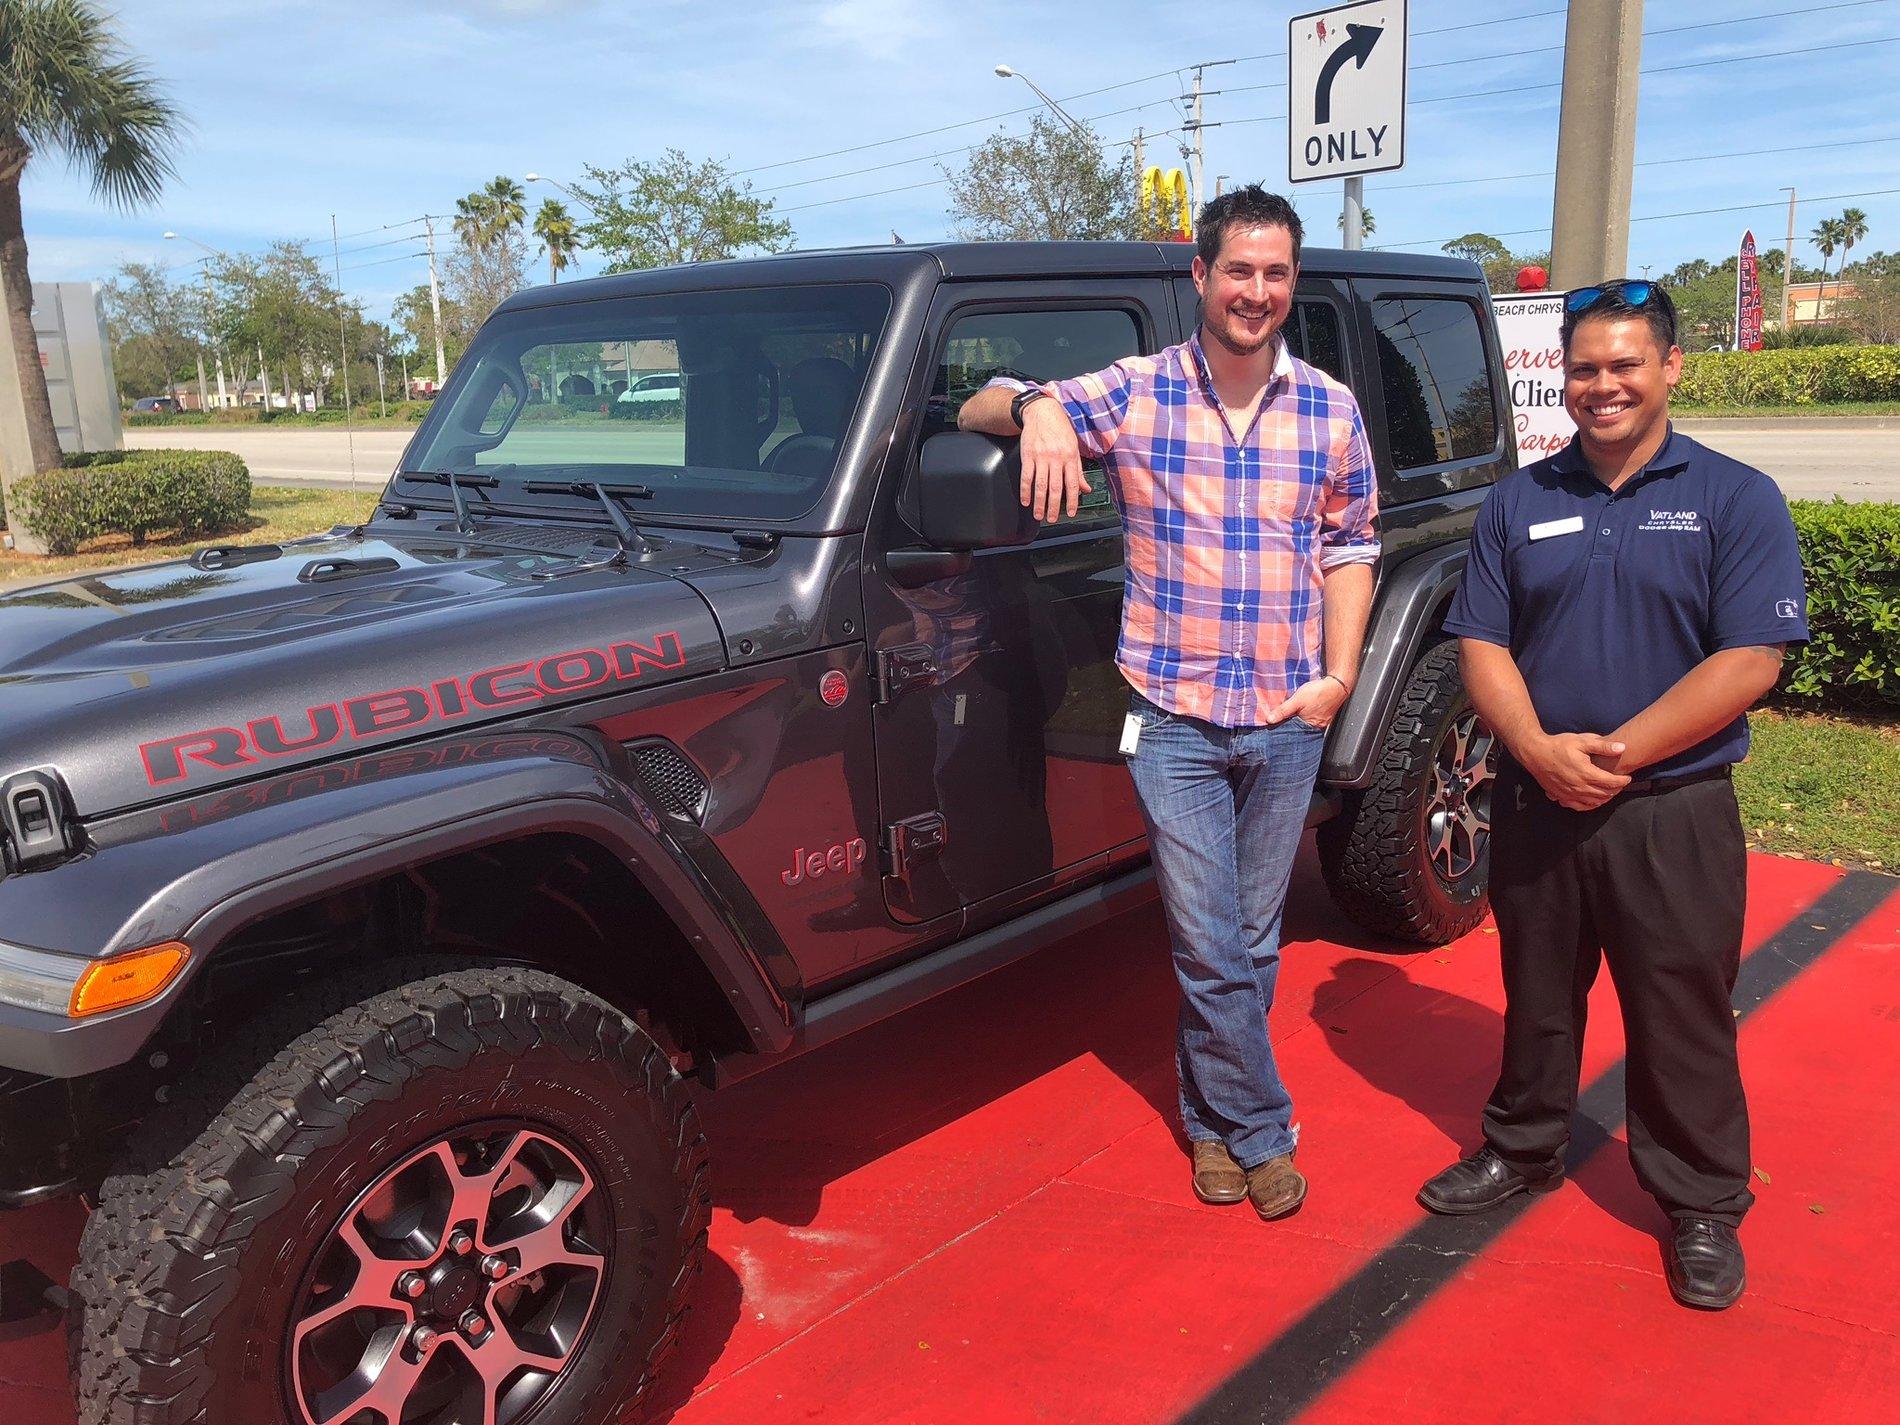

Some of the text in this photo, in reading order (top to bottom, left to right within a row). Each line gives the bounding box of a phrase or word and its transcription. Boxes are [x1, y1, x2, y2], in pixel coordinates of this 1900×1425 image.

[1305, 125, 1388, 166] ONLY
[1494, 302, 1564, 316] BEACH CHRYS
[1741, 248, 1752, 350] CELL PHONE
[1504, 347, 1566, 371] erve
[1513, 413, 1571, 458] Carpe
[1649, 509, 1697, 520] VATLAND
[138, 631, 686, 786] RUBICON
[781, 837, 867, 886] Jeep
